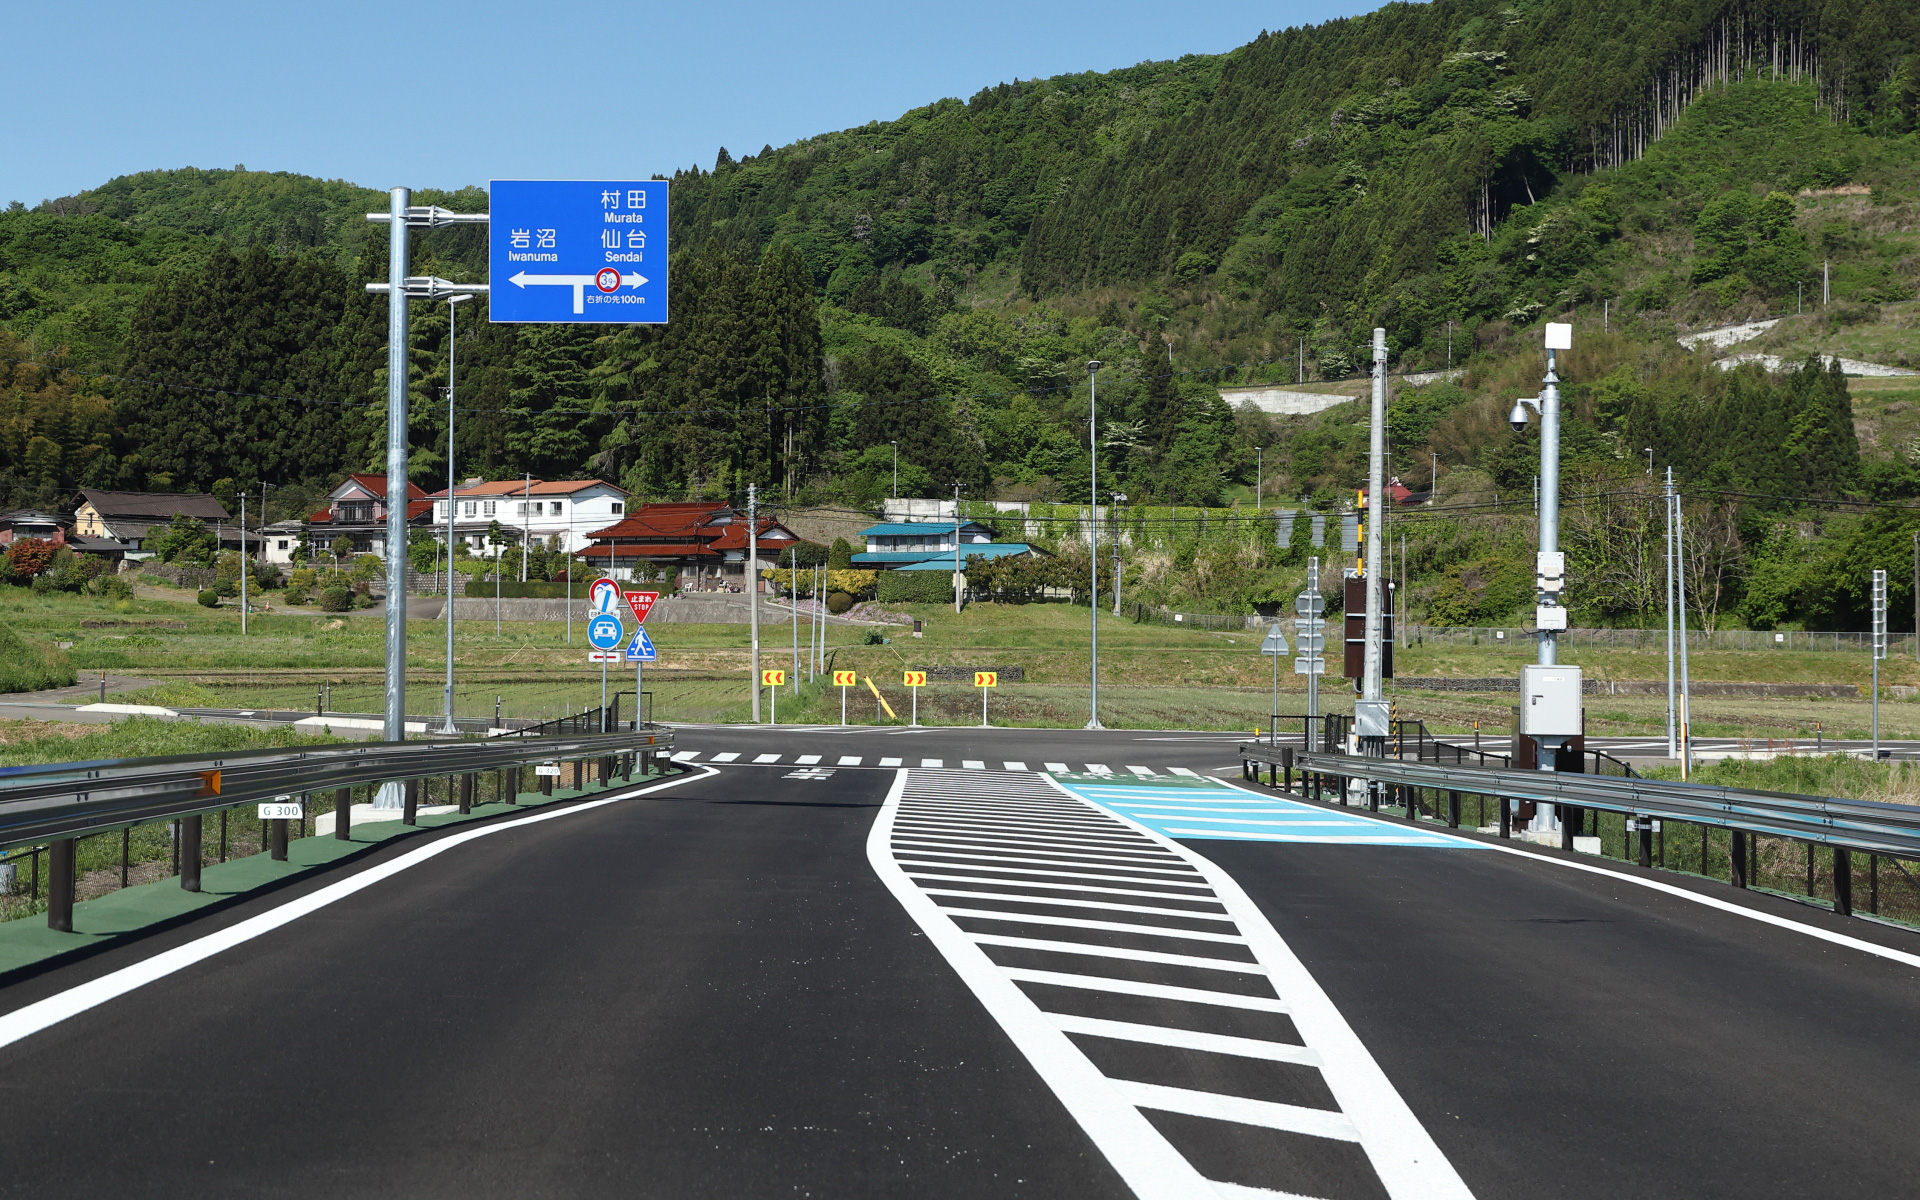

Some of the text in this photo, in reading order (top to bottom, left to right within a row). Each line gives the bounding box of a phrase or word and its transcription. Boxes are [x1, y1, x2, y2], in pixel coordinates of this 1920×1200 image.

[600, 189, 646, 210] 村田
[604, 212, 643, 223] Murata
[510, 228, 556, 248] 岩沼
[600, 228, 647, 249] 仙台
[508, 250, 558, 262] Iwanuma
[605, 251, 643, 262] Sendai
[586, 295, 645, 304] 右折の先100m
[630, 595, 652, 603] 止まれ
[263, 806, 298, 816] G 300
